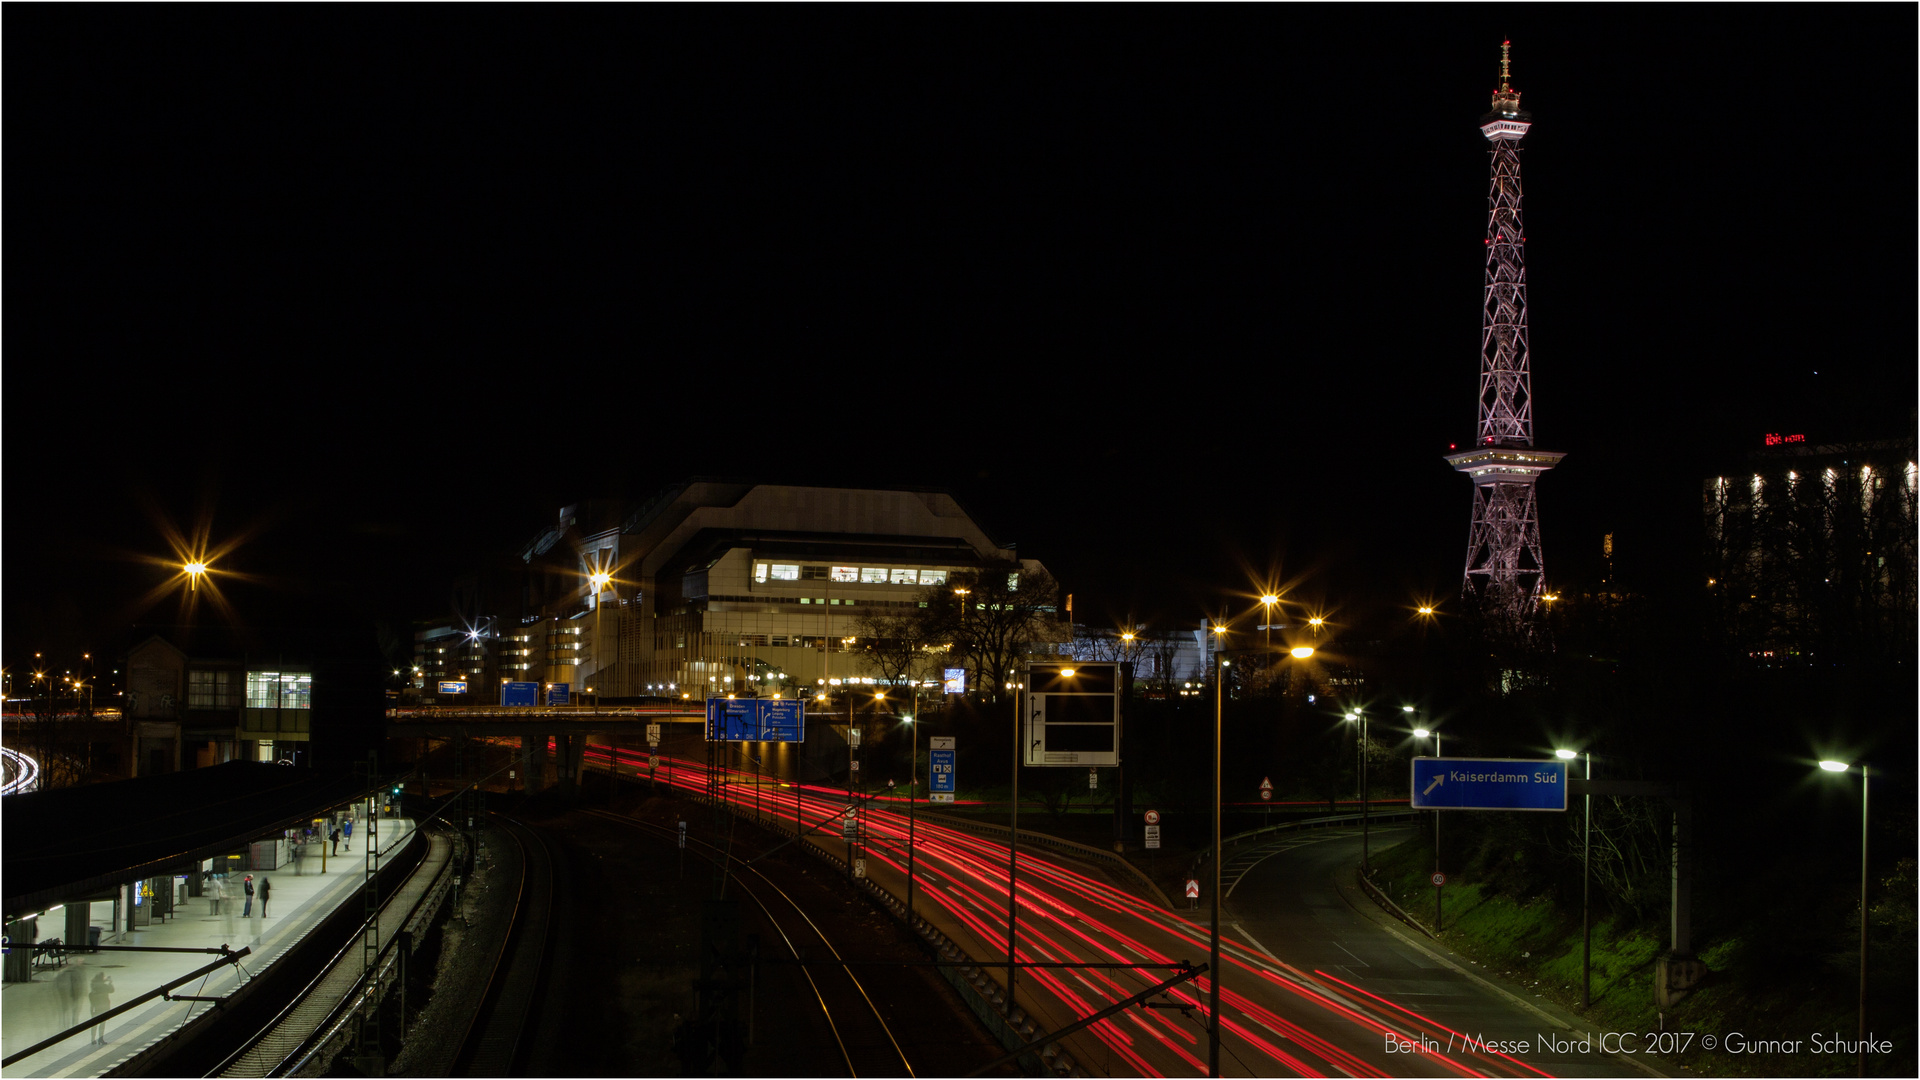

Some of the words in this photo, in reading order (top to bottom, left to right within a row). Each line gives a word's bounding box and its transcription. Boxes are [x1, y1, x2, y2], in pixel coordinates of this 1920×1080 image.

[1450, 770, 1528, 783] Kaiserdamm
[1534, 772, 1557, 784] Süd
[1434, 875, 1443, 883] 60
